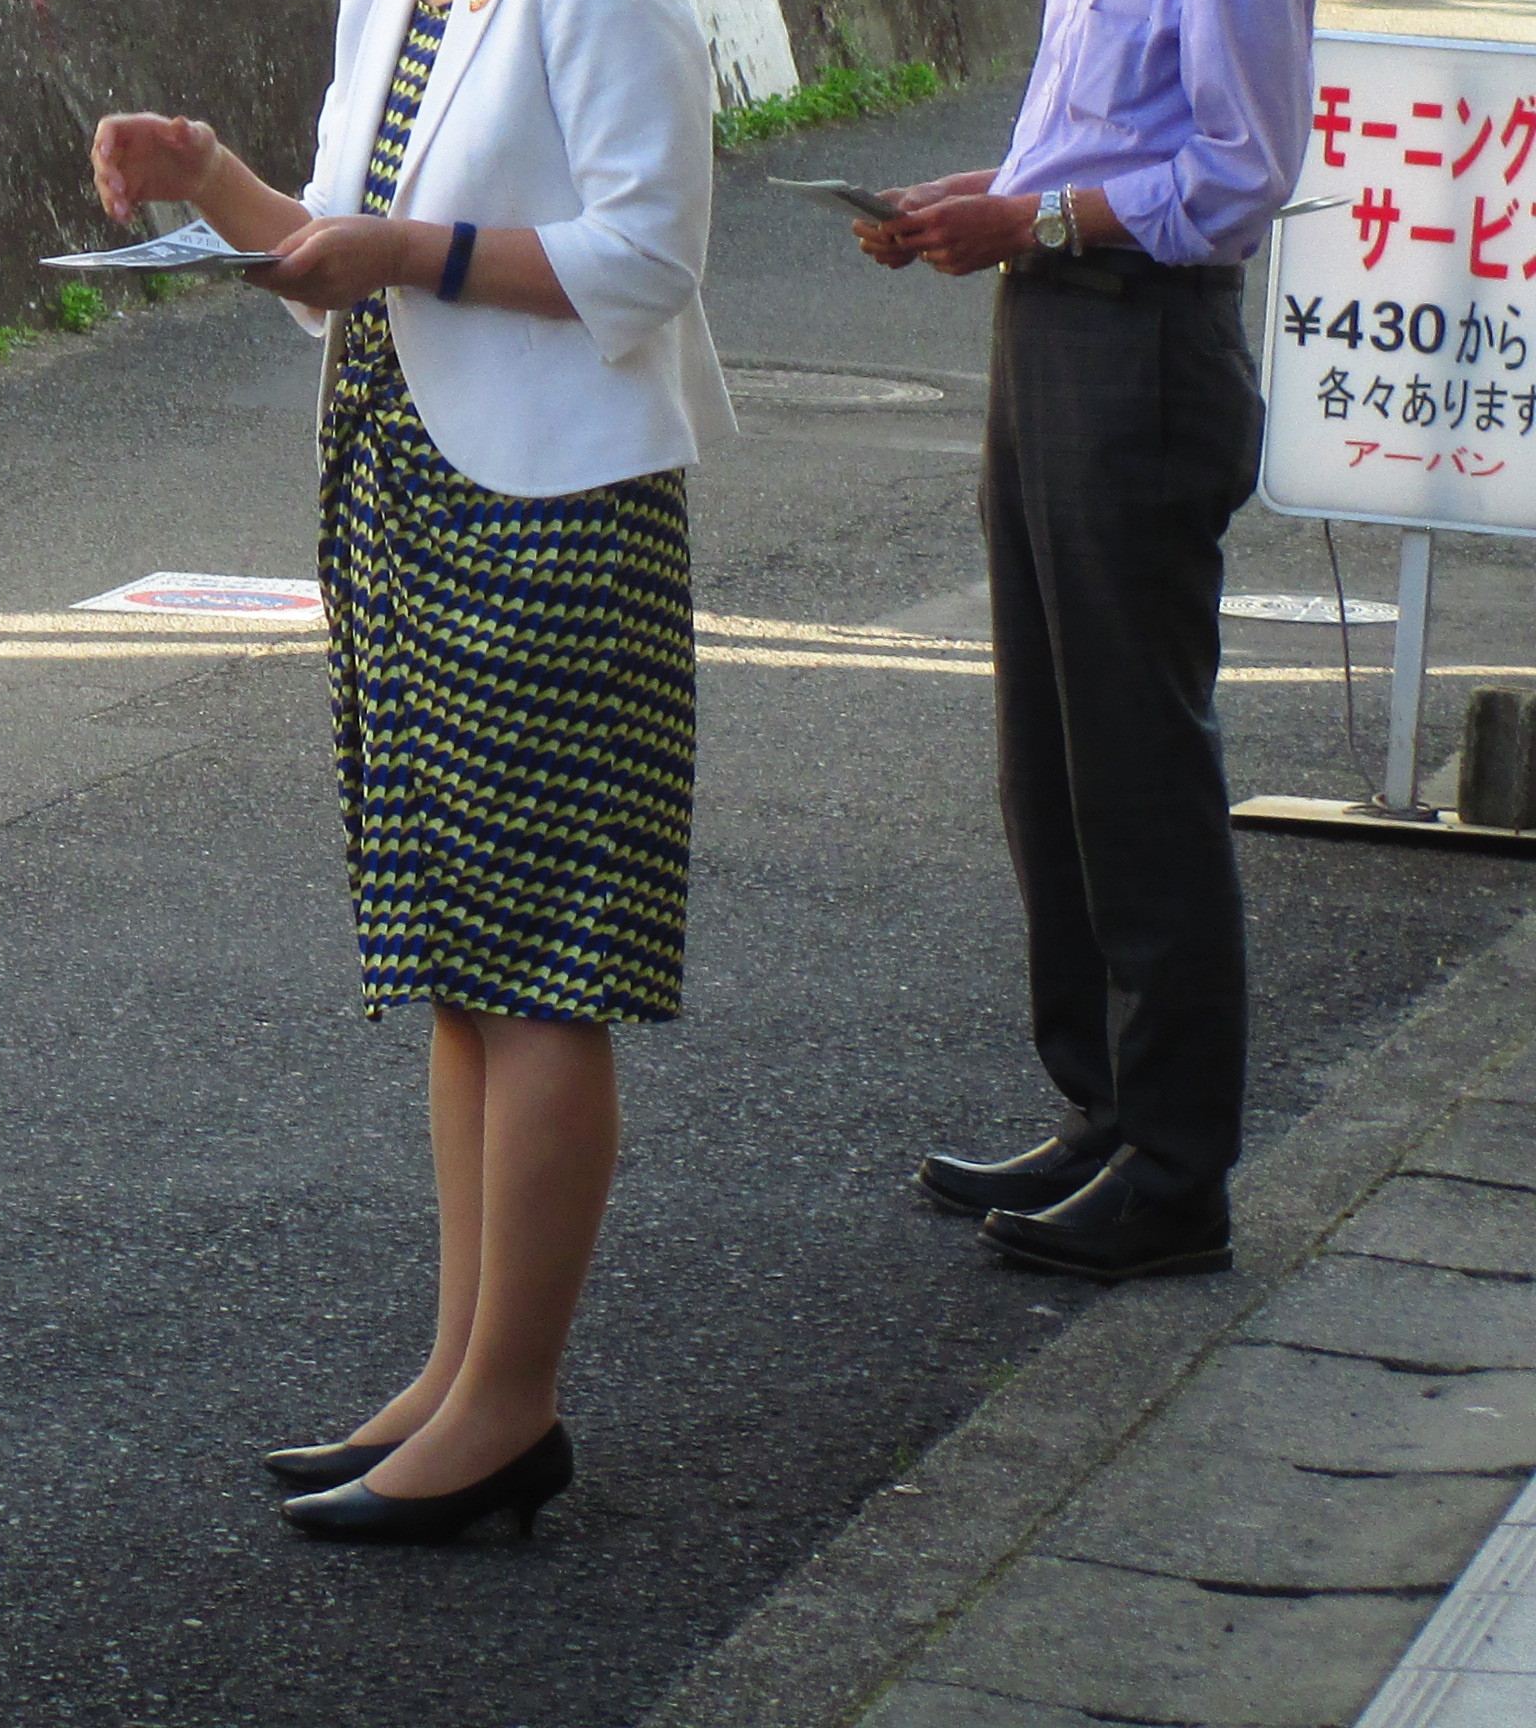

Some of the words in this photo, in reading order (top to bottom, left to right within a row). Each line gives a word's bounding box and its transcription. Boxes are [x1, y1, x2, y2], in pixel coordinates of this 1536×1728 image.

[1313, 86, 1536, 185] モーニング
[1317, 366, 1536, 436] 各々あります
[1344, 440, 1505, 477] アーバン
